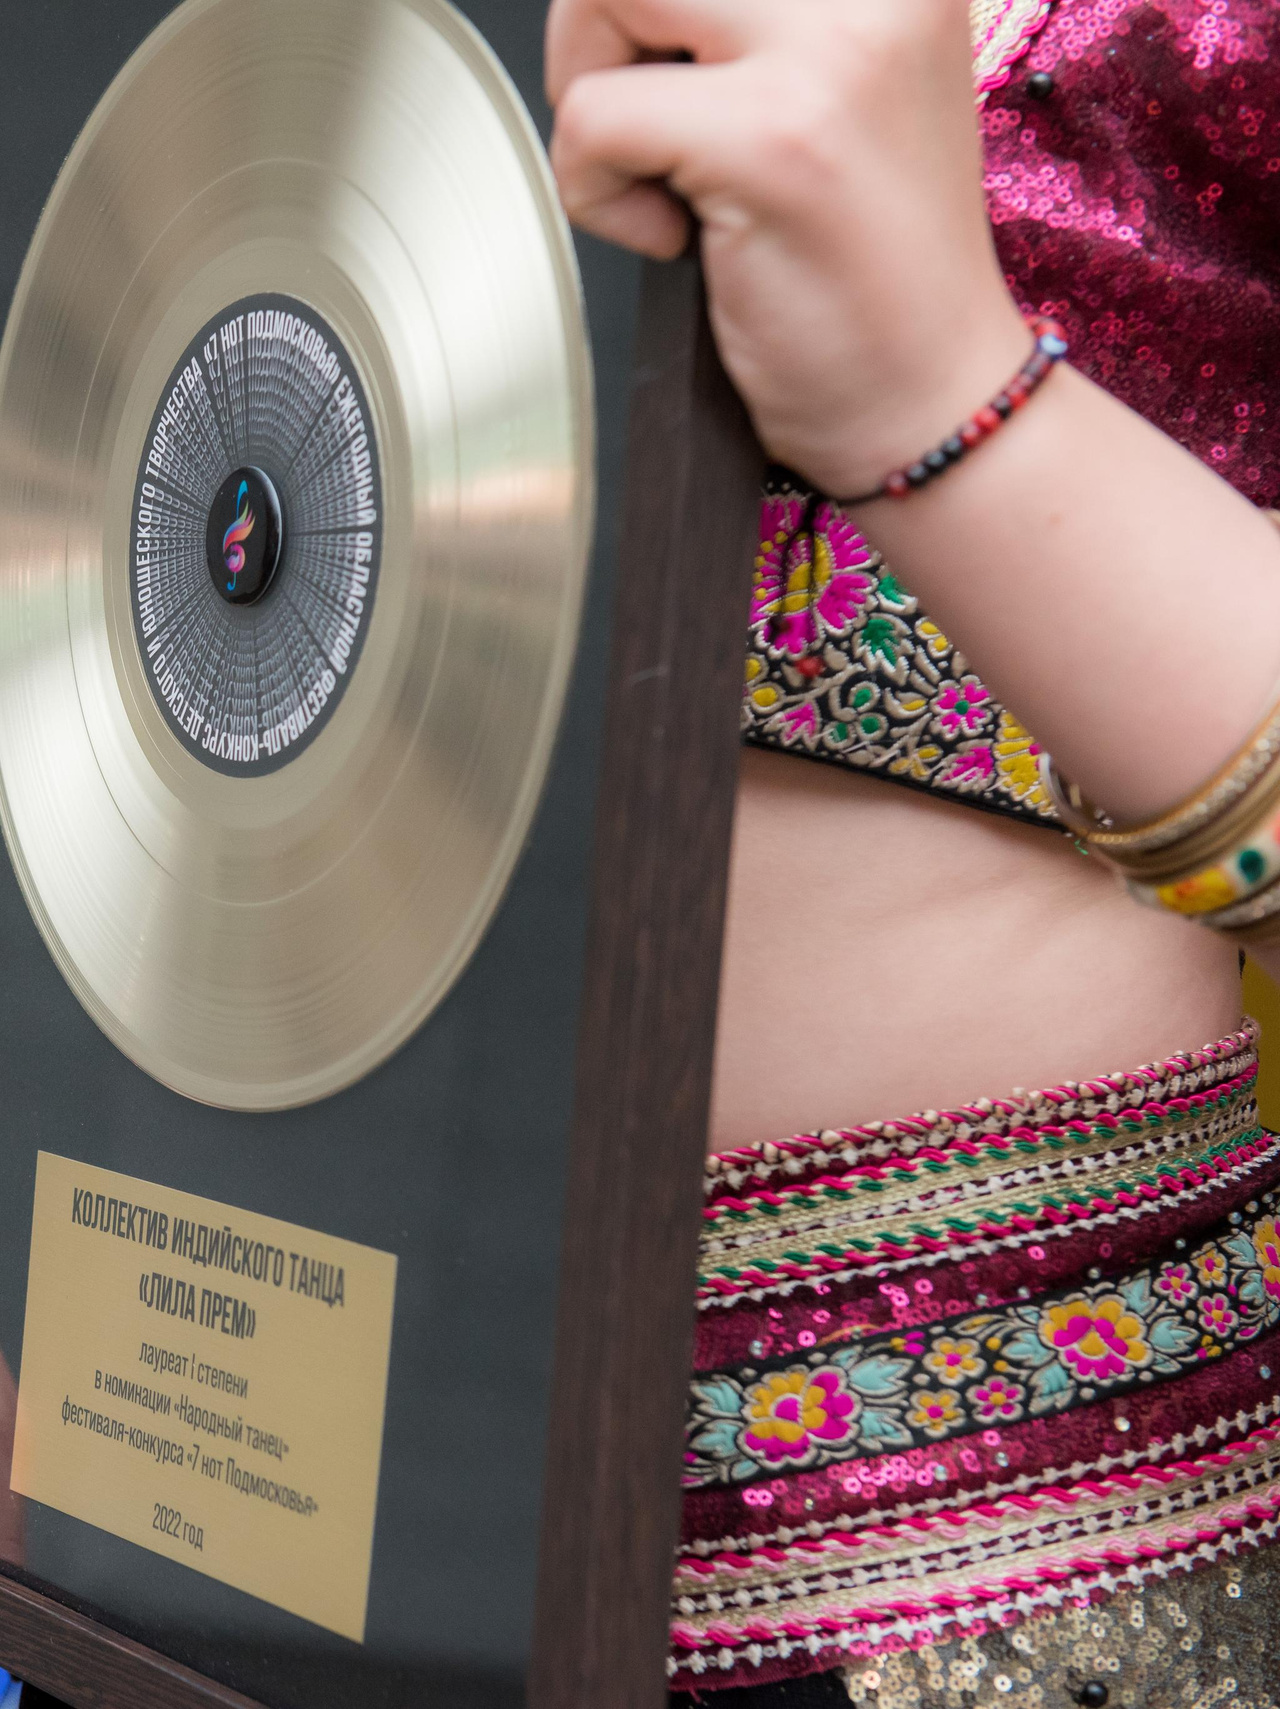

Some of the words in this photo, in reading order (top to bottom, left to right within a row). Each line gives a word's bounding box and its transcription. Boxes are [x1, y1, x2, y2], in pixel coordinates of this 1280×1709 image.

[220, 315, 244, 352] НОТ
[247, 310, 341, 385] ПОДМОСКОВЬЯ»
[145, 356, 202, 478] ТВОРЧЕСТВА
[333, 375, 376, 526] ЕЖЕГОДНЫЙ
[136, 482, 157, 638] ЮНОШЕСКОГО
[329, 532, 373, 674] ОБЛАСТНОЙ
[147, 635, 162, 658] И
[153, 654, 204, 741] ДЕТСКОГО
[202, 669, 336, 762] ФЕСТИВАЛЬ-КОНКУРС
[72, 1187, 169, 1250] КОЛЛЕКТИВ
[171, 1217, 284, 1287] ИНДИЙСКОГО
[289, 1252, 345, 1308] ТАНЦА
[139, 1272, 195, 1322] «ЛИЛА
[199, 1288, 256, 1340] ПРЕМ»
[94, 1369, 102, 1389] в
[104, 1373, 171, 1416] номинации
[174, 1393, 243, 1443] «Народный
[246, 1425, 289, 1462] танец»
[139, 1342, 189, 1374] лауреат
[197, 1362, 249, 1399] степени
[61, 1394, 184, 1466] фестиваля-конкурса
[187, 1443, 200, 1471] «7
[201, 1455, 224, 1482] нот
[225, 1457, 318, 1517] Подмосковья»
[152, 1502, 181, 1538] 2022
[183, 1521, 204, 1551] год
